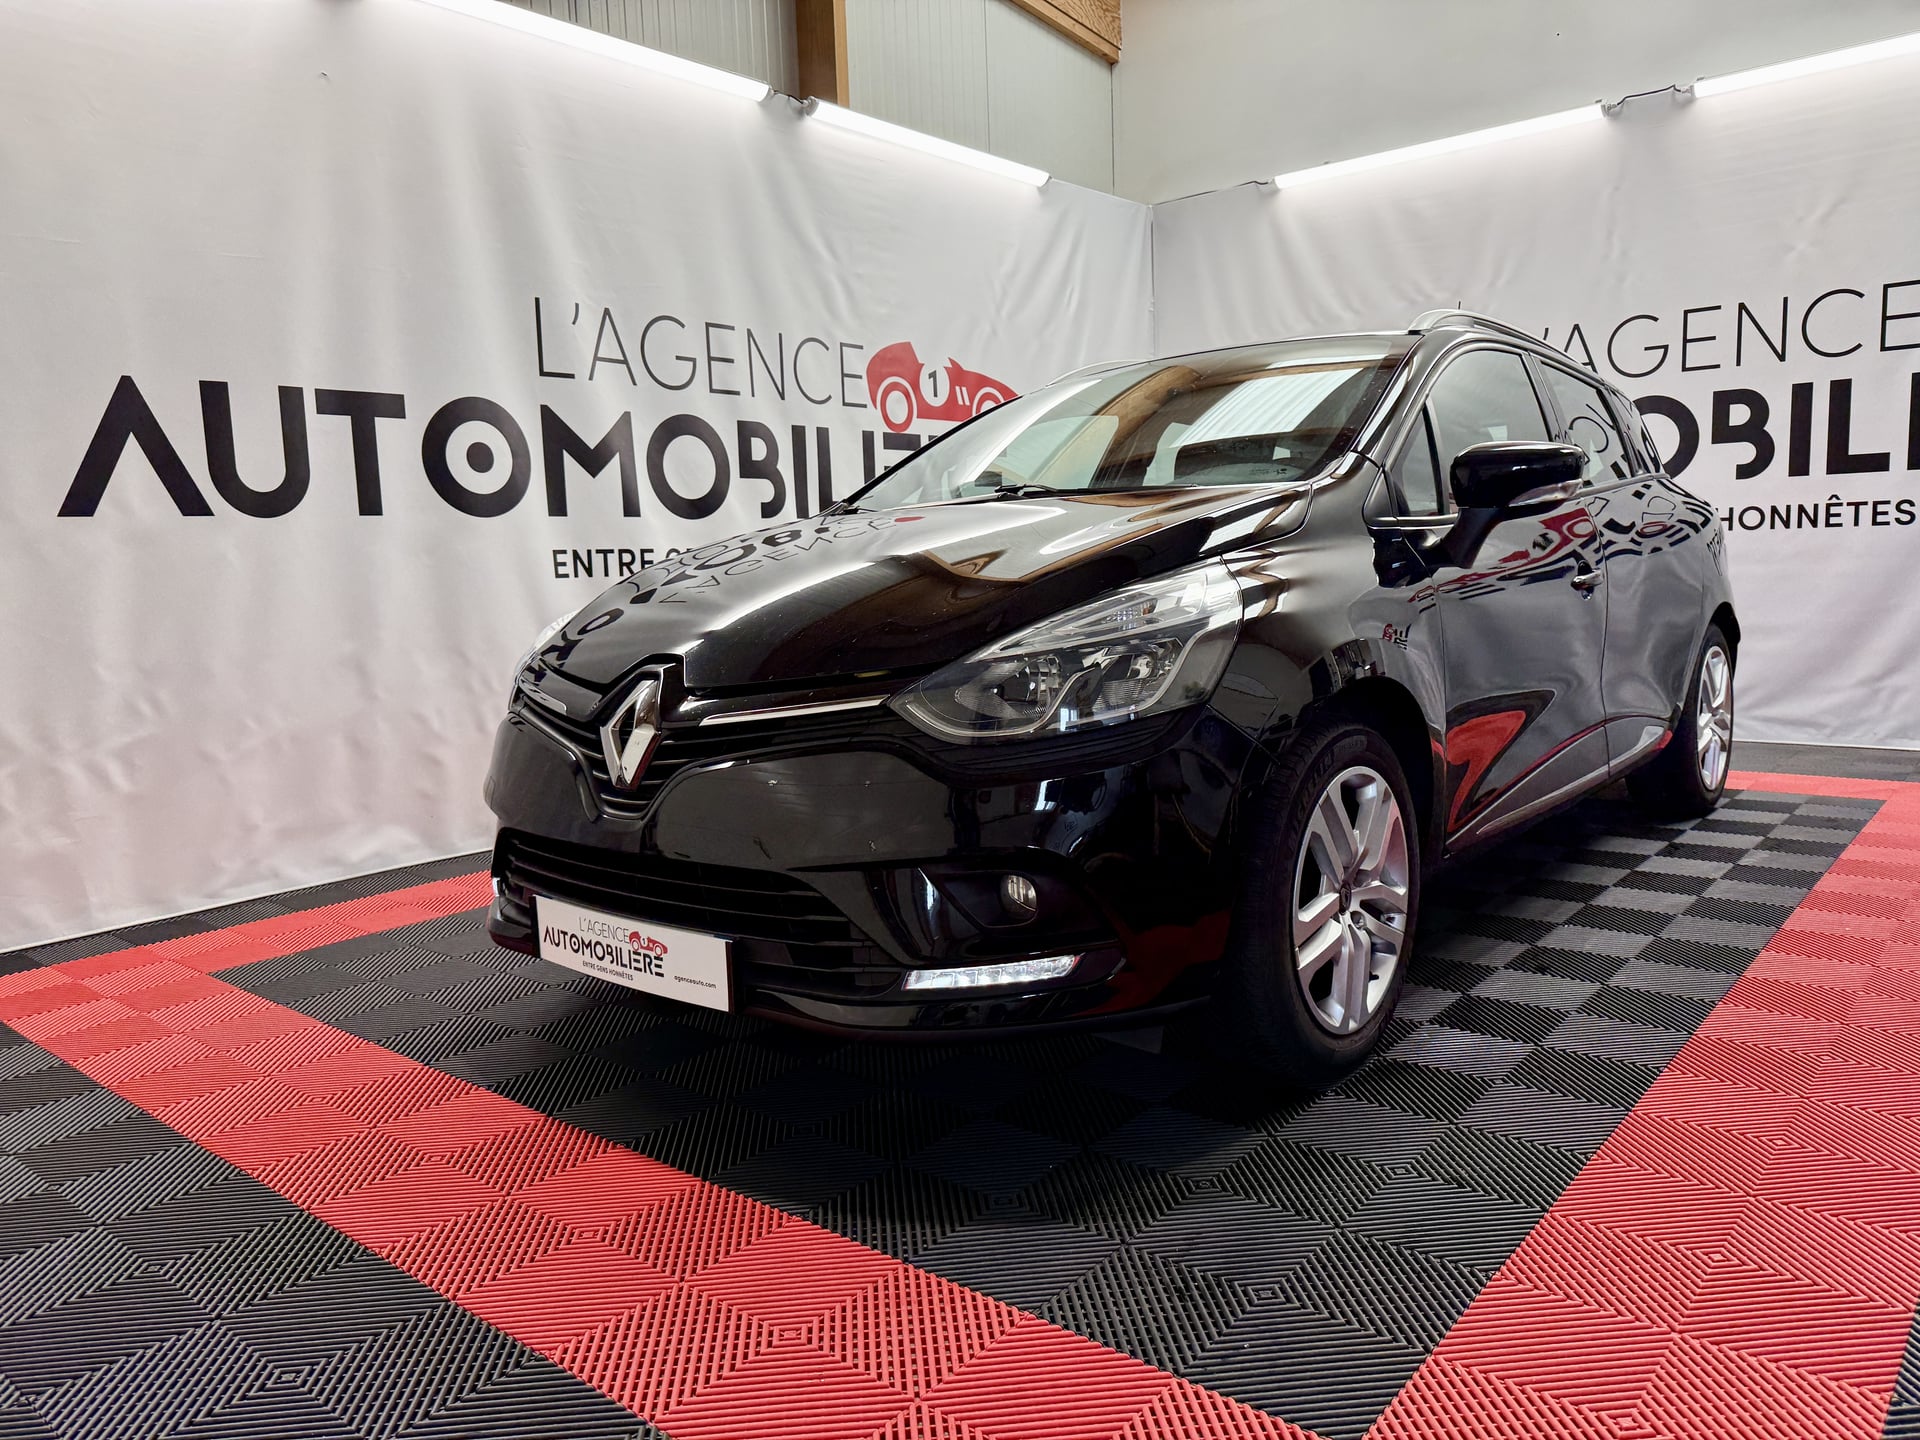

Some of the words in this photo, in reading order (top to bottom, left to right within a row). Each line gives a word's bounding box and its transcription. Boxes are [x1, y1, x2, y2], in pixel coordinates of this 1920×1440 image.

[535, 296, 867, 408] L'AGENCE
[928, 369, 940, 398] 1
[552, 548, 654, 579] ENTRE
[578, 916, 631, 945] L'AGENCE
[582, 960, 596, 971] ENTRE
[596, 963, 609, 975] GENS
[608, 967, 634, 982] HONNÊTES
[674, 974, 717, 989] agenceauto.com
